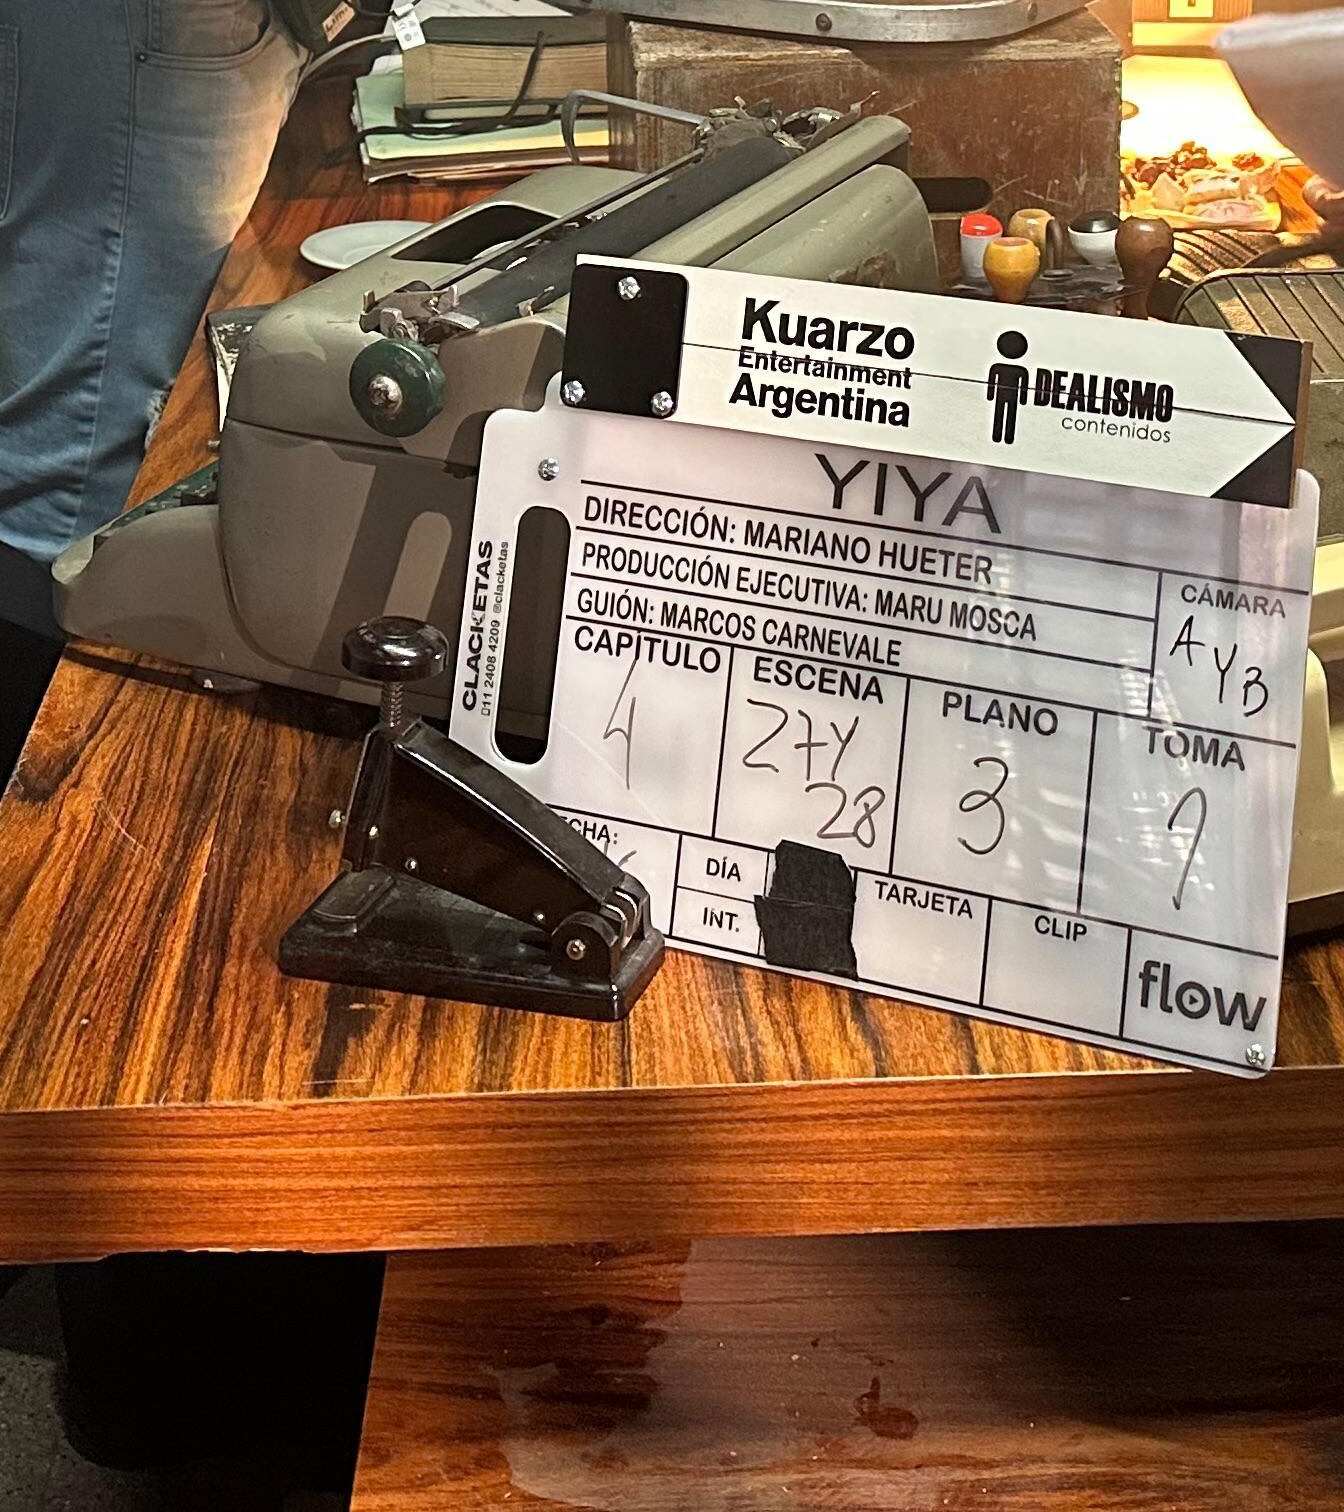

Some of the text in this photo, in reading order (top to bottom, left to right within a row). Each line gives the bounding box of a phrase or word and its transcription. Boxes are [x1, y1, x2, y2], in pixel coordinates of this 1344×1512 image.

[741, 296, 915, 360] Kuarzo
[738, 345, 912, 389] Entertainment
[728, 372, 910, 428] Argentina
[1061, 416, 1171, 443] contenidos
[814, 452, 1002, 535] YIYA
[584, 495, 993, 585] DIRECCIÓN: MARIANO HUETER
[582, 541, 1037, 642] PRODUCCIÓN EJECUTIVA: MARU MOSCA
[1180, 582, 1286, 619] CÁMARA
[462, 540, 493, 712] CLACKETAS
[488, 619, 501, 653] 4209
[574, 625, 722, 674] CAPÍTULO
[577, 588, 902, 667] GUIÓN: MARCOS CARNEVALE
[484, 655, 497, 689] 2408
[754, 656, 884, 704] ESCENA
[1169, 615, 1269, 717] A Y B
[942, 691, 1058, 737] PLANO
[1142, 724, 1246, 772] TOMA
[805, 782, 885, 848] 28
[957, 756, 1008, 855] 3
[706, 855, 741, 882] DÍA
[703, 906, 740, 933] INT.
[874, 880, 974, 920] TARJETA
[1034, 914, 1088, 942] CLIP
[1138, 959, 1268, 1033] flow
